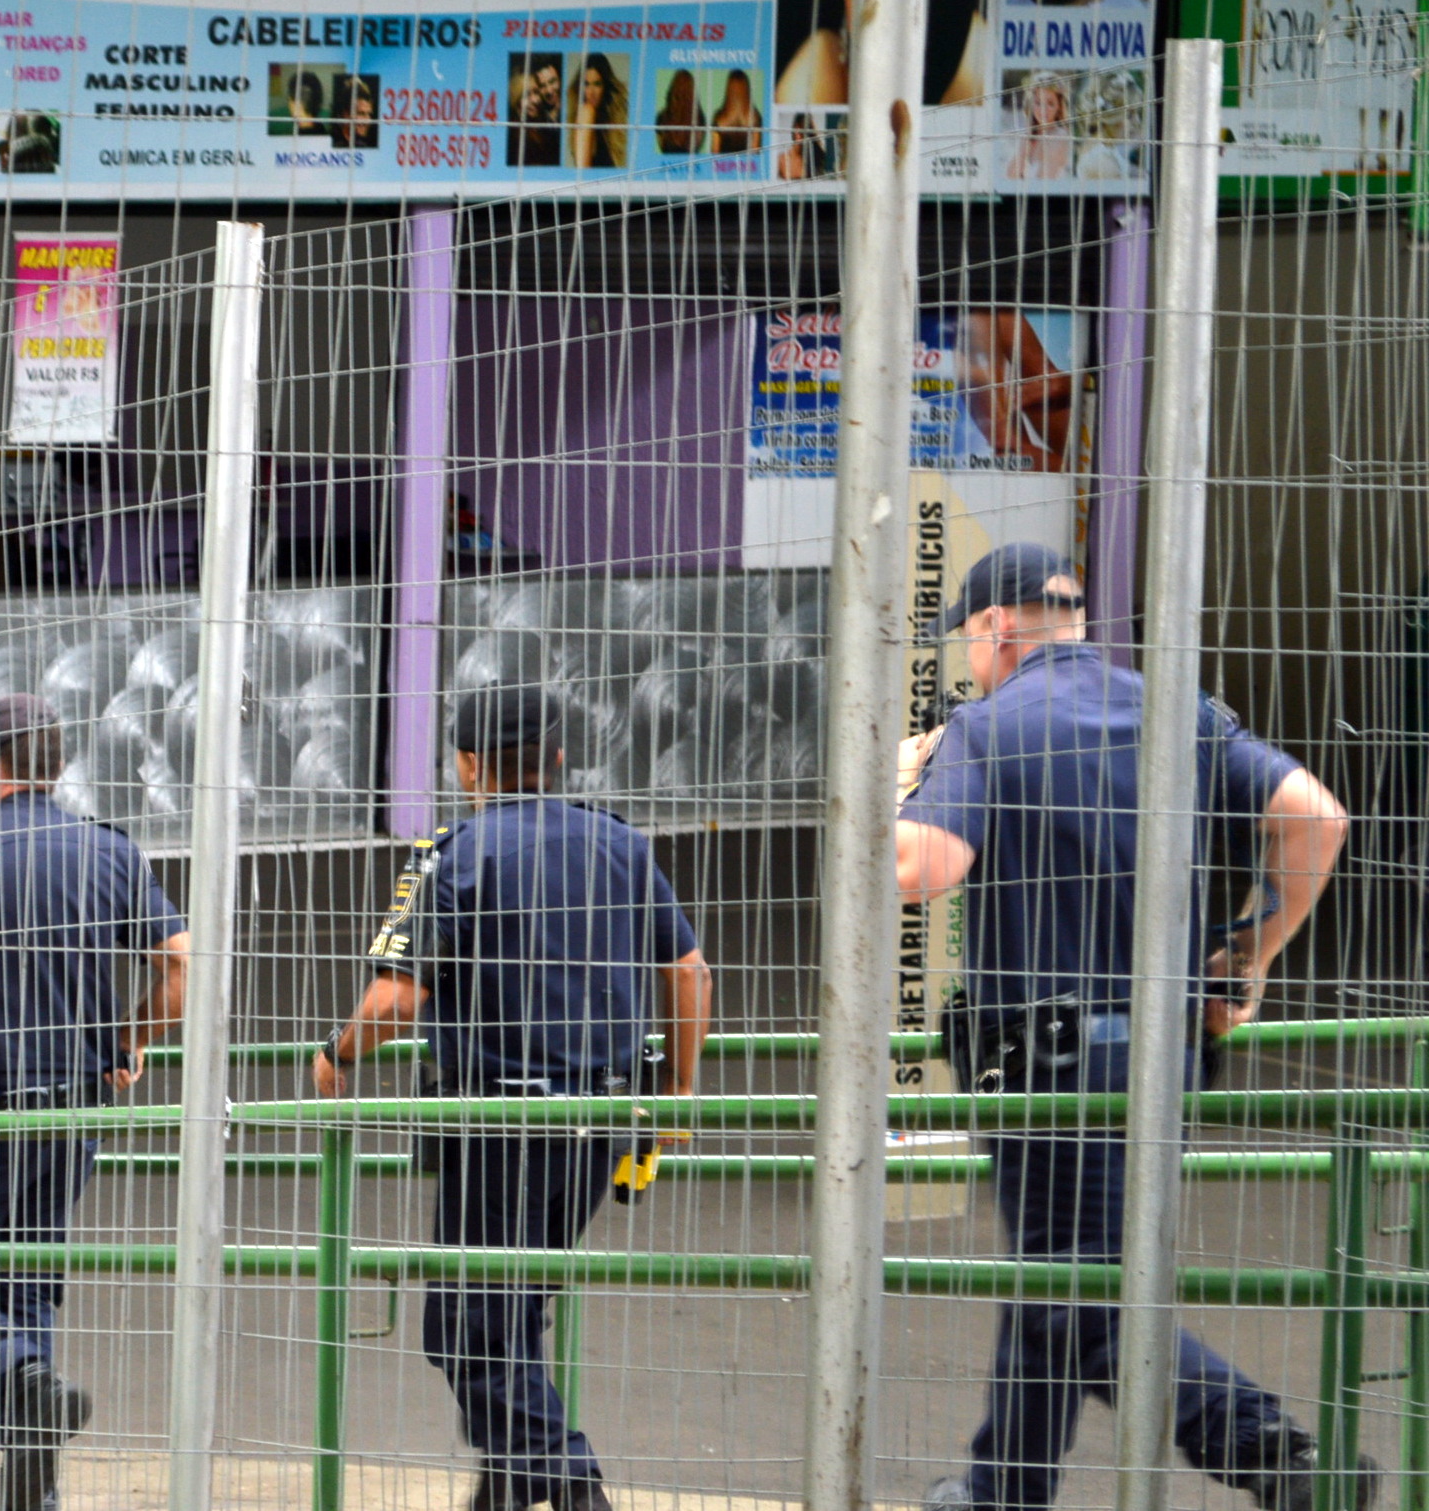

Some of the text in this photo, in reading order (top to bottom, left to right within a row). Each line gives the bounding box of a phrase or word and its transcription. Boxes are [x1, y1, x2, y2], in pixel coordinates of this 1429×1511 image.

[208, 16, 482, 48] CABELEIREIROS
[503, 20, 727, 42] PROFISSIONAIS
[1003, 21, 1148, 58] DIA DA NOIVA
[105, 45, 187, 65] CORTE
[13, 66, 60, 82] DRED
[84, 73, 250, 94] MASCULINO
[94, 103, 235, 123] FEMININO
[383, 88, 498, 124] 32360024
[201, 150, 255, 166] GERAL
[19, 247, 115, 269] MANICURE
[26, 367, 76, 381] VALOR
